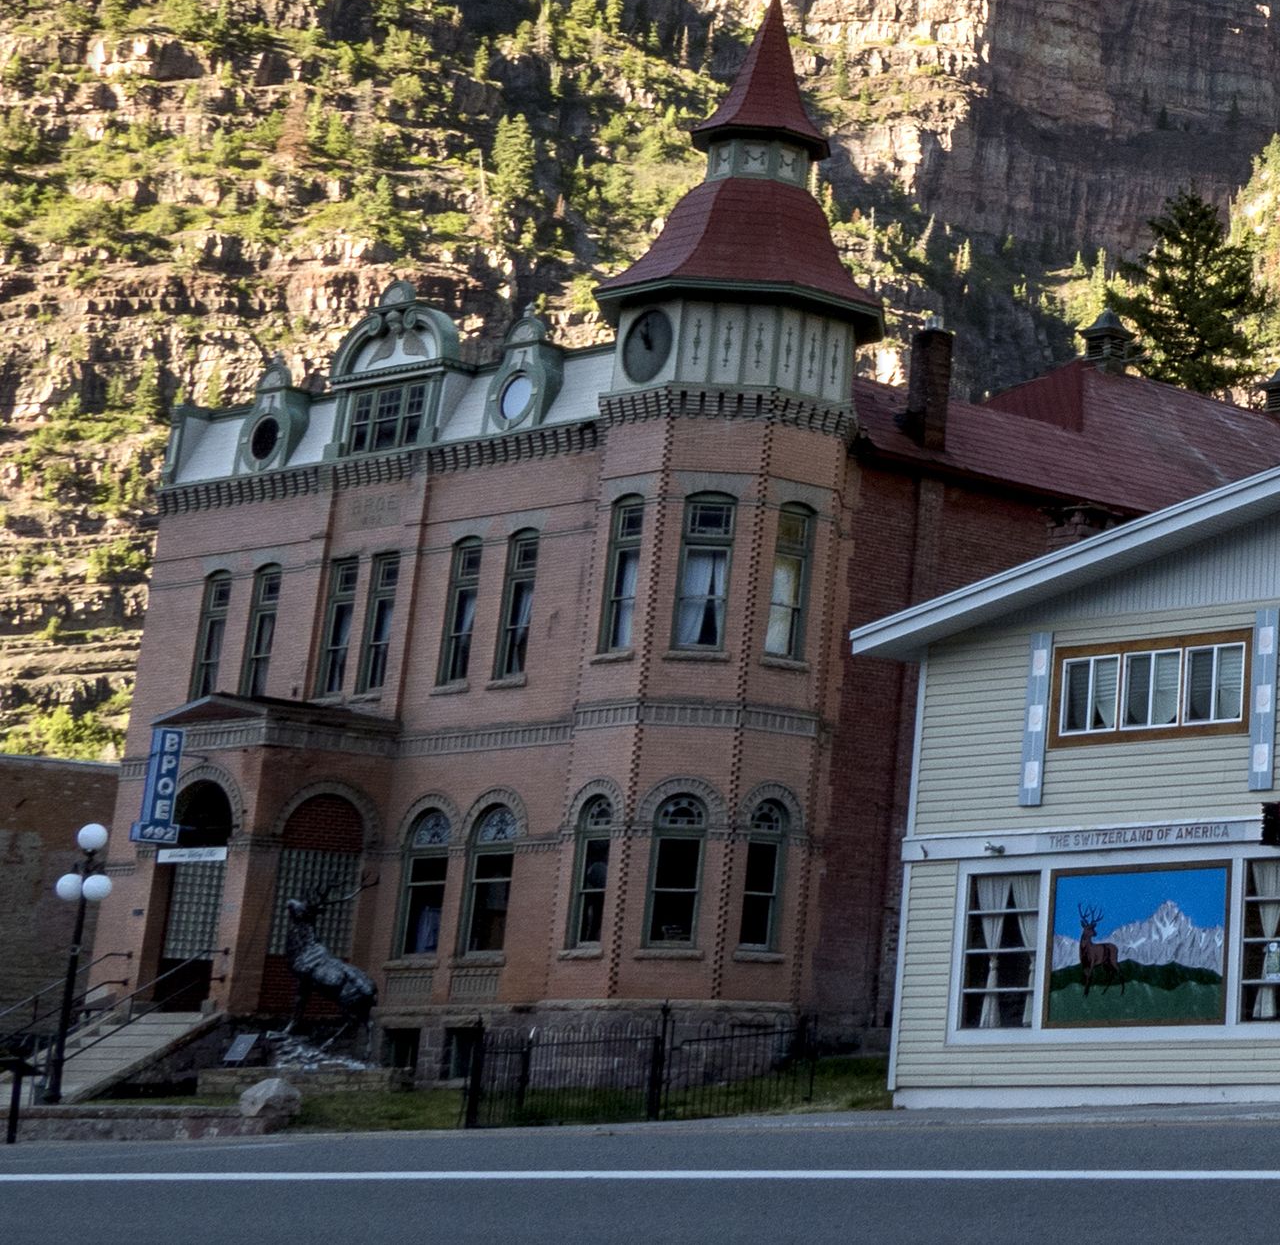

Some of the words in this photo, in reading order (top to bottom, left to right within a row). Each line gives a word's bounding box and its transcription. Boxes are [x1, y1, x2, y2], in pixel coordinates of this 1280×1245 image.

[154, 733, 180, 820] BPOE
[143, 826, 176, 840] 492
[1049, 835, 1070, 848] THE
[1073, 829, 1153, 846] SWITZERLAND
[1157, 828, 1171, 841] OF
[1175, 825, 1230, 840] AMERICA
